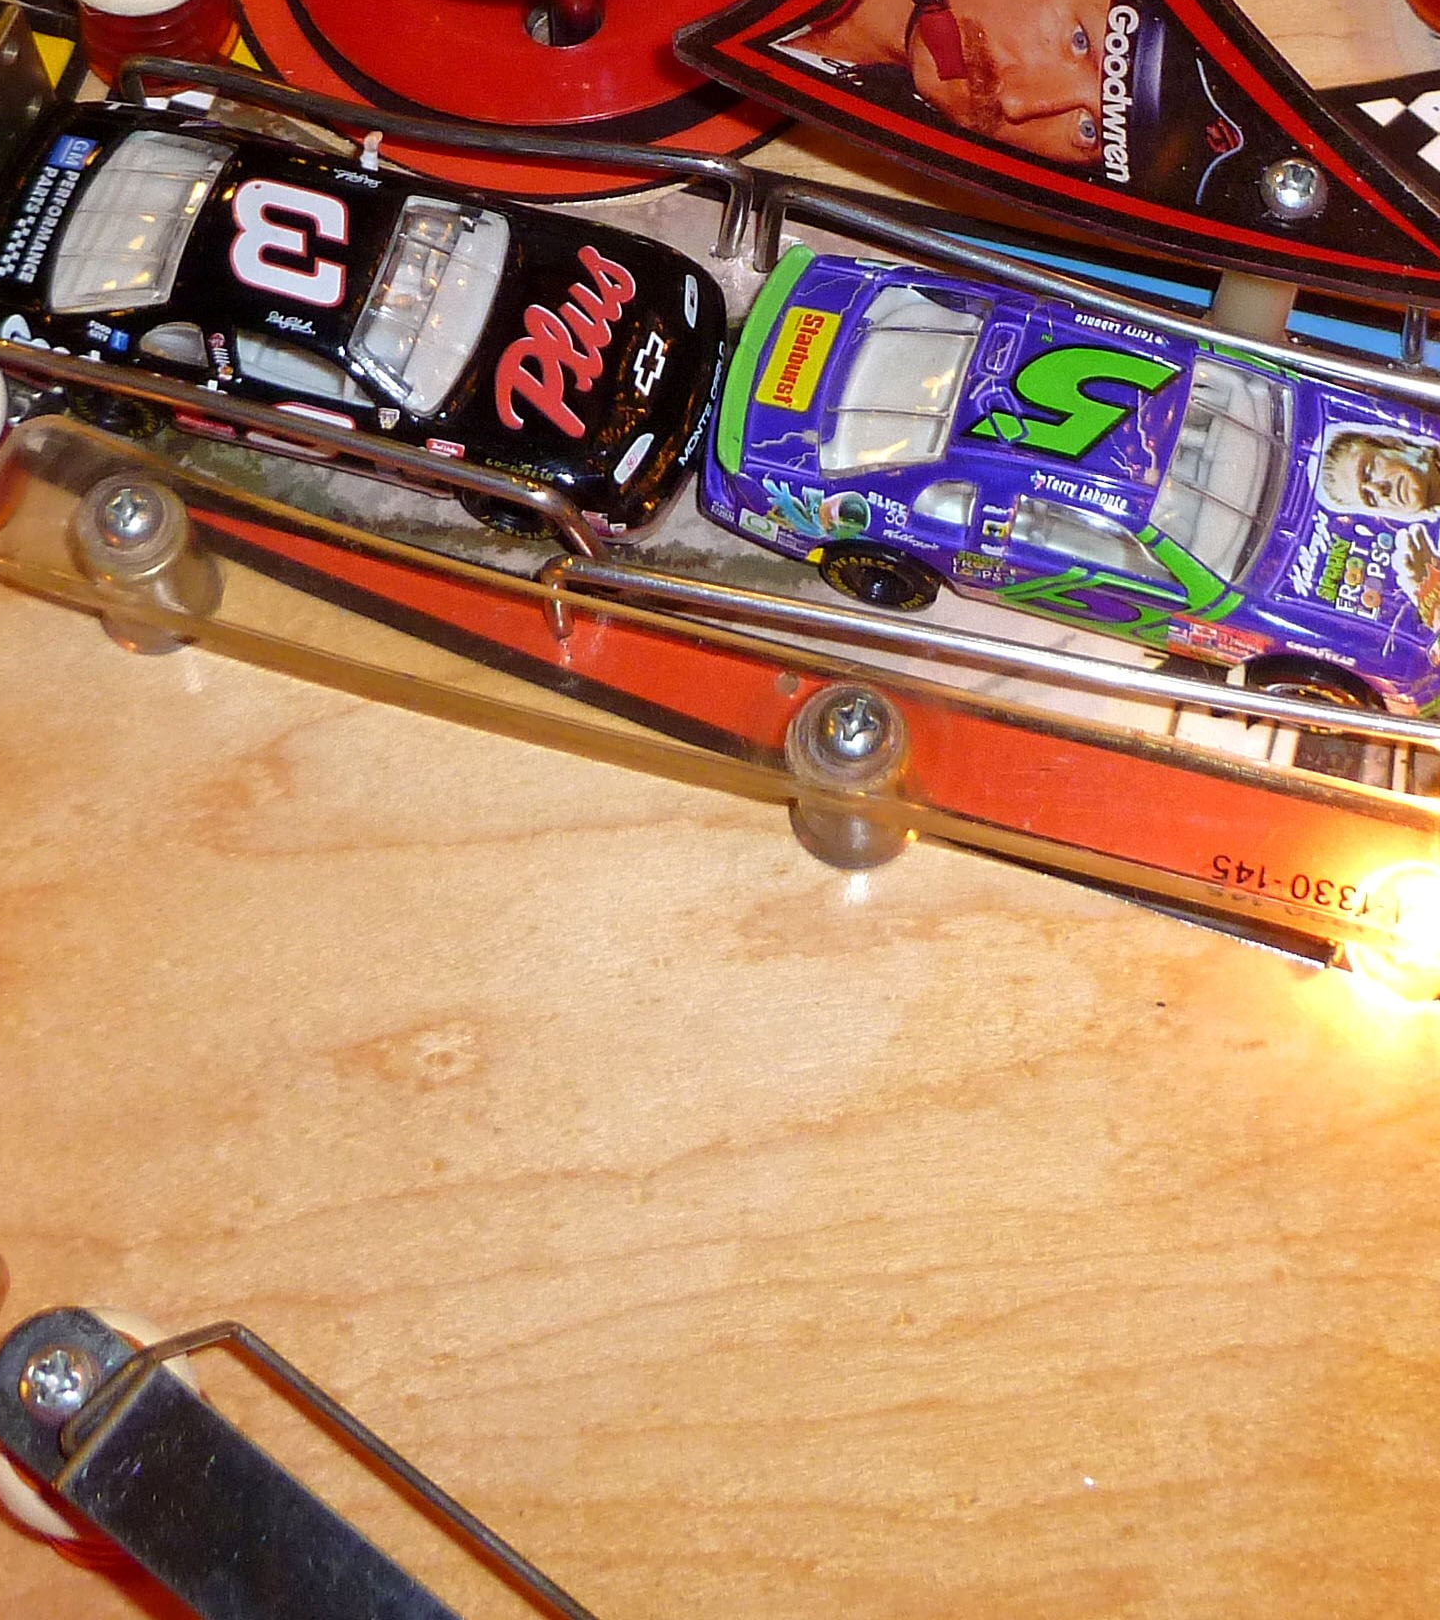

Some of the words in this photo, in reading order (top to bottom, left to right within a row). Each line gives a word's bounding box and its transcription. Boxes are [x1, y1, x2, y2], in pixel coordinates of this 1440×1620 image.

[65, 140, 91, 167] GM
[23, 166, 60, 215] PARTS
[17, 169, 81, 284] PERFORMANCE
[230, 178, 350, 308] 3
[494, 245, 637, 440] Plus
[1074, 312, 1122, 336] Labonte
[1124, 325, 1161, 346] Terry
[772, 313, 826, 405] Starburst
[677, 402, 713, 467] MONTE
[961, 345, 1186, 463] 5
[1045, 475, 1079, 499] Terry
[1078, 484, 1129, 509] Labonte
[1211, 854, 1402, 925] -1330-145
